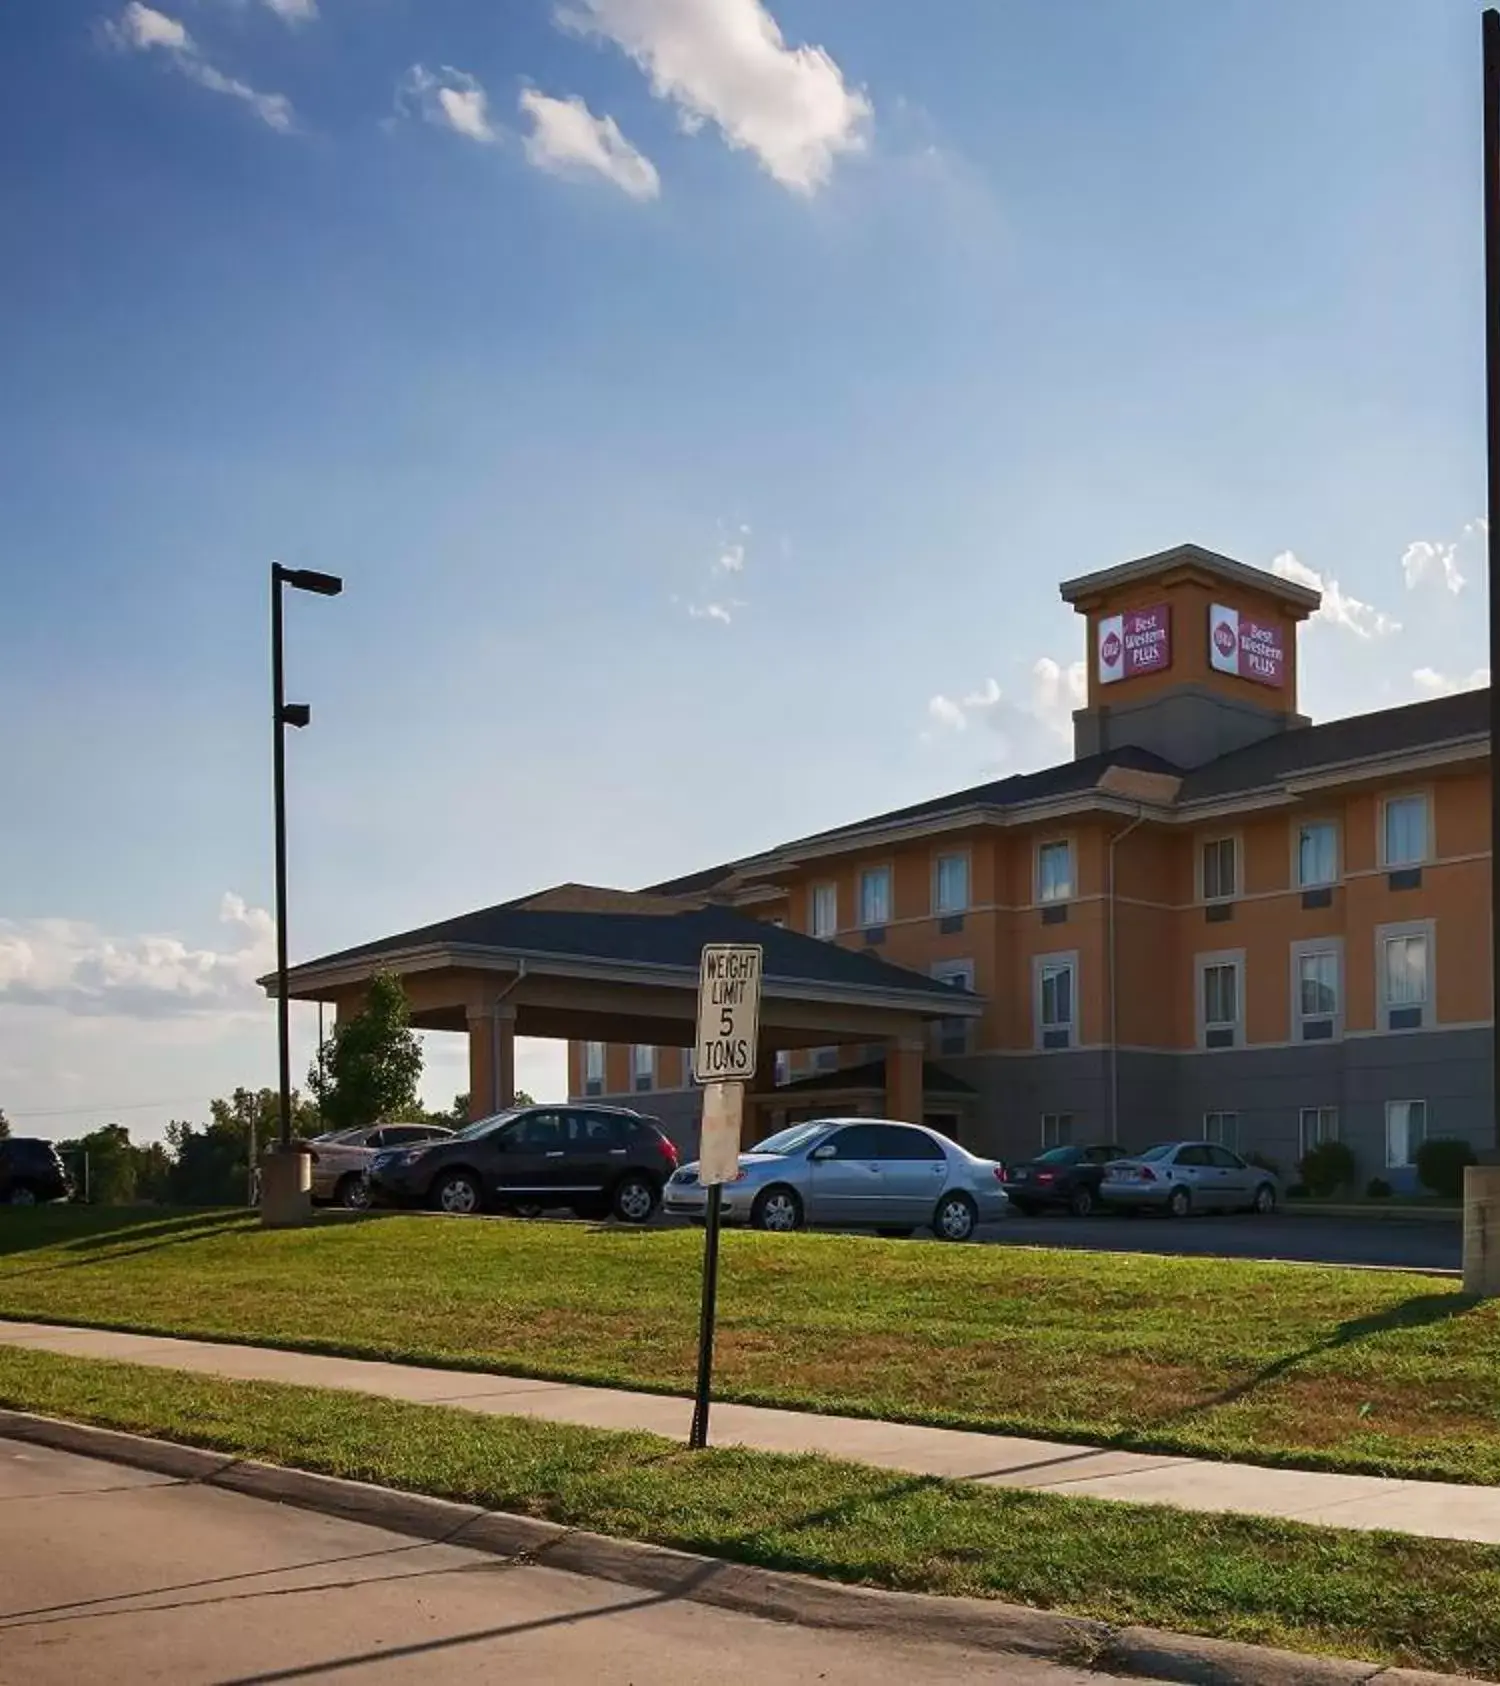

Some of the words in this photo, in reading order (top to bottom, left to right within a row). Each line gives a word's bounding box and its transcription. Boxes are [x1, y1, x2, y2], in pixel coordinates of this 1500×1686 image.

[707, 954, 757, 979] WEIGHT
[711, 980, 747, 1005] LIMIT
[719, 1007, 734, 1037] 5
[705, 1039, 748, 1070] TONS
